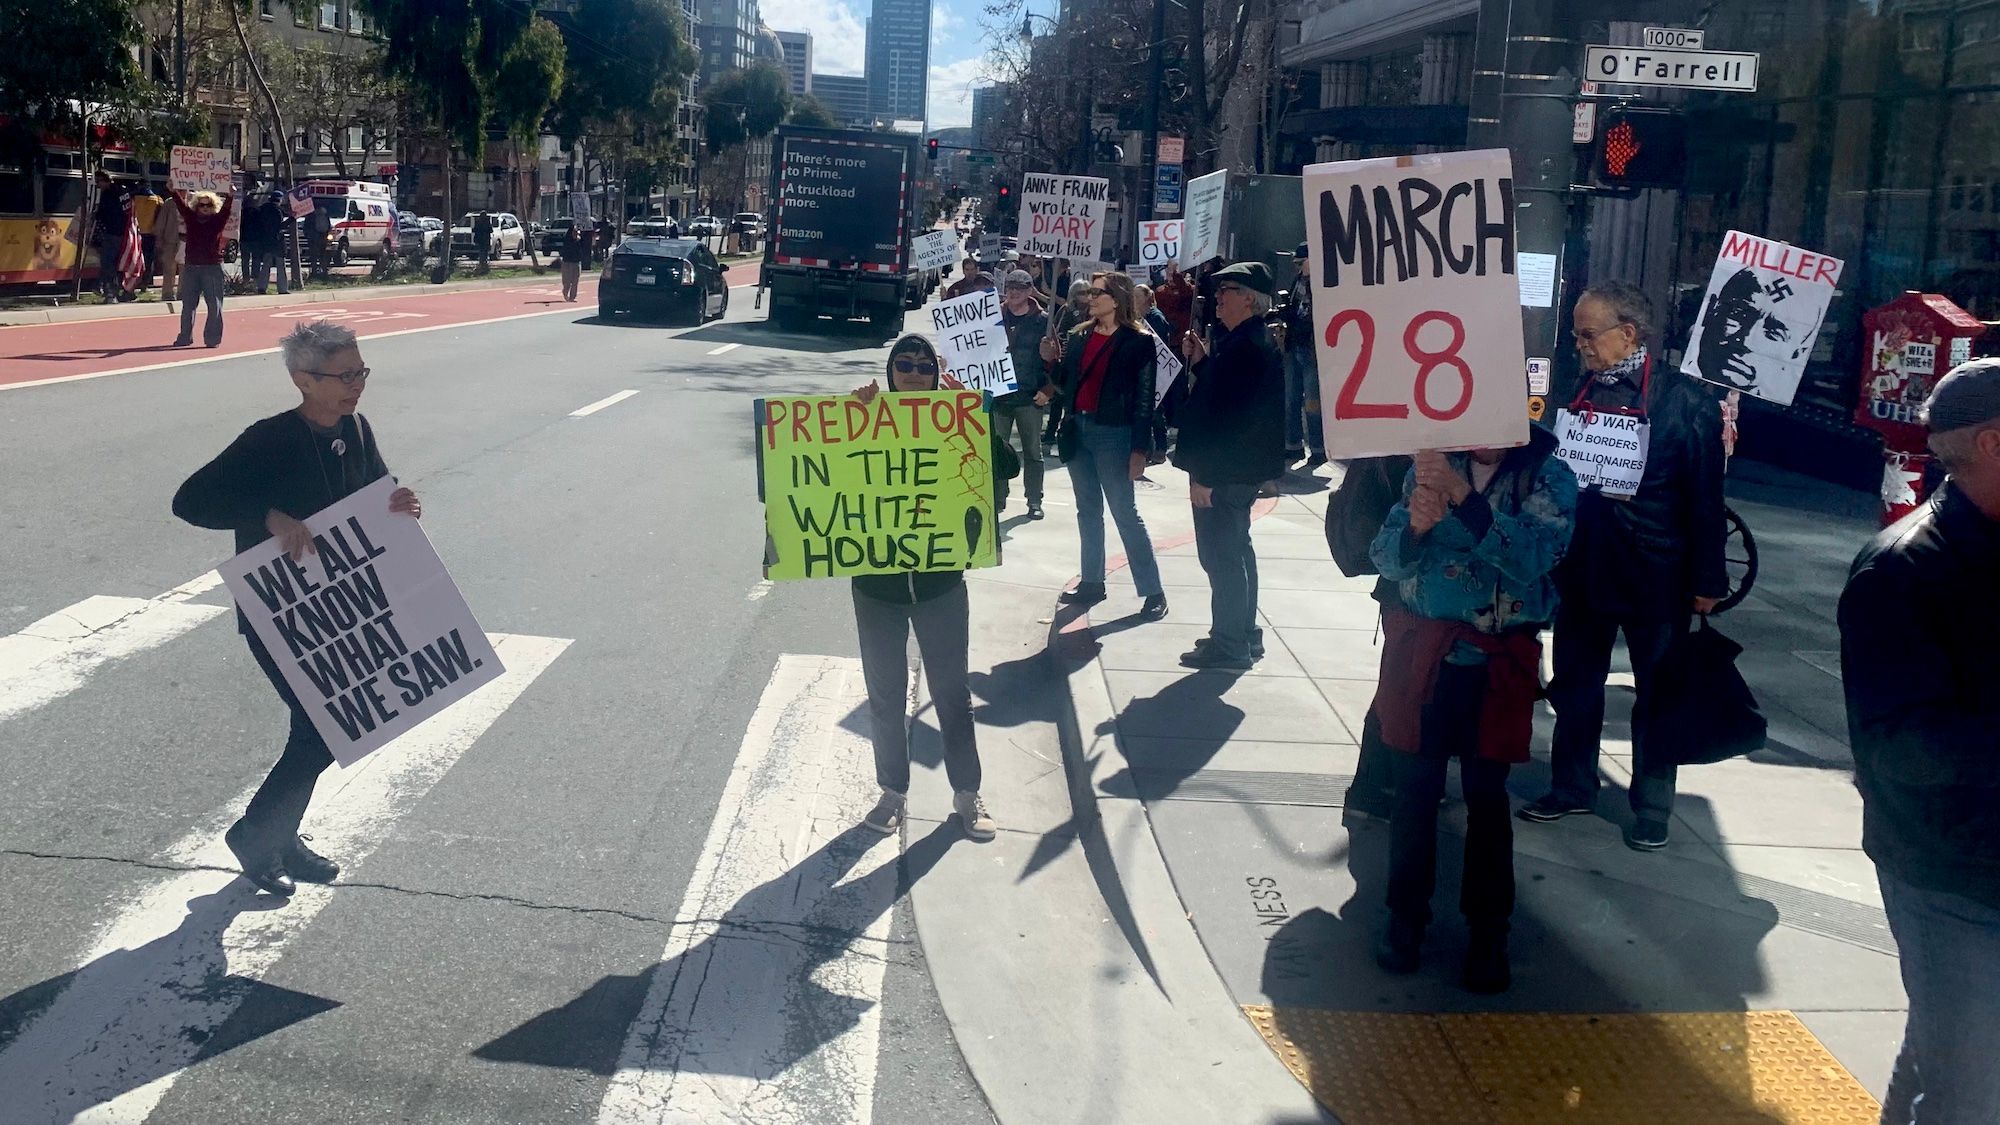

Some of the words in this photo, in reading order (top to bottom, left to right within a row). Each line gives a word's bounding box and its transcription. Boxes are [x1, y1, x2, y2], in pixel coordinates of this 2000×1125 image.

[1649, 30, 1685, 46] 1000
[1601, 54, 1741, 82] O'Farrell
[173, 147, 214, 165] epstein
[788, 152, 831, 166] There's
[835, 158, 867, 168] more
[170, 168, 204, 182] Trump
[787, 166, 800, 177] to
[803, 167, 842, 180] Prime.
[200, 180, 217, 190] US
[785, 183, 795, 193] A
[798, 184, 855, 198] truckload
[1024, 177, 1057, 195] ANNE
[1062, 180, 1107, 201] FRANK
[785, 198, 819, 209] more.
[1029, 198, 1075, 216] wrote
[1080, 204, 1090, 217] a
[781, 228, 823, 239] amazon
[925, 231, 944, 242] STOP
[1032, 214, 1096, 240] DIARY
[1143, 222, 1184, 242] IC
[1319, 178, 1515, 288] MARCH
[917, 248, 945, 260] AGENTS
[947, 243, 957, 252] OF
[929, 240, 944, 248] THE
[1023, 237, 1062, 255] about
[1067, 240, 1091, 257] this
[1142, 242, 1177, 260] OU
[927, 254, 953, 267] DEATH!
[1721, 232, 1838, 288] MILLER
[932, 293, 999, 331] REMOVE
[949, 329, 987, 352] THE
[1325, 309, 1474, 421] 28
[765, 392, 986, 449] PREDATOR
[1578, 412, 1599, 425] NO
[1602, 415, 1637, 432] WAR
[1585, 434, 1638, 451] BORDERS
[792, 453, 830, 488] IN
[846, 448, 939, 486] THE
[1569, 449, 1643, 470] BILLIONAIRES
[1599, 476, 1638, 490] TERROR
[787, 492, 938, 537] WHITE
[243, 551, 321, 614] WE
[313, 515, 386, 583] ALL
[272, 564, 390, 658] KNOW
[297, 610, 409, 699] WHAT
[324, 677, 399, 742] WE
[387, 628, 483, 707] SAW.
[1246, 877, 1291, 927] NESS
